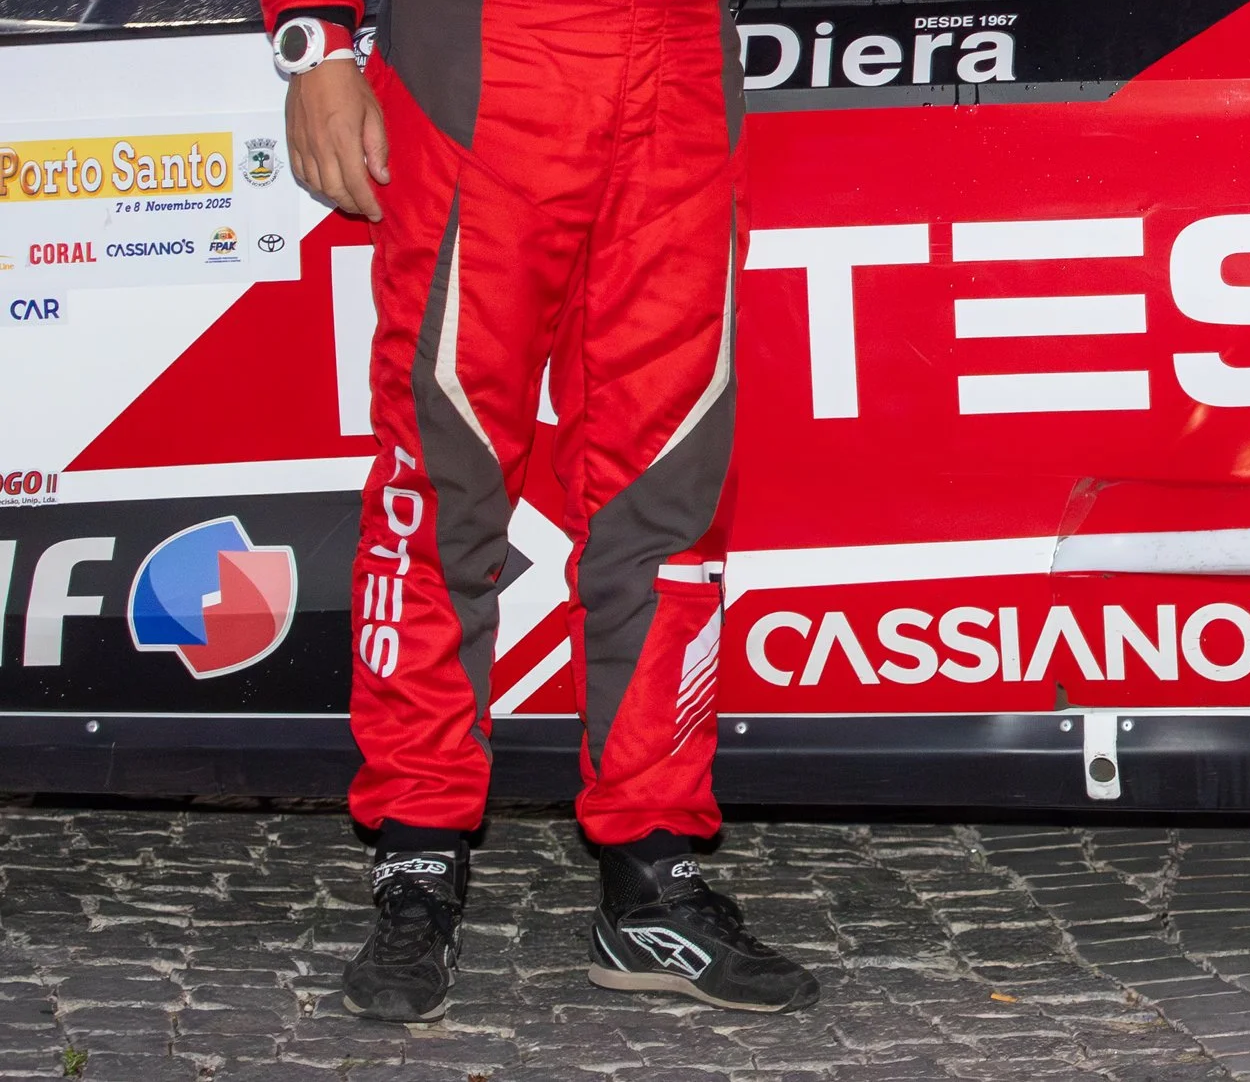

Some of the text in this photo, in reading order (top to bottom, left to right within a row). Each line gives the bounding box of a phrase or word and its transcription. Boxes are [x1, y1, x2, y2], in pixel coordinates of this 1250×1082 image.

[914, 14, 1018, 29] DESDE 1967
[735, 21, 1017, 90] Diera
[0, 140, 228, 196] Porto Santo
[115, 202, 123, 213] 7
[133, 202, 141, 212] 8
[145, 199, 204, 212] Novembro
[205, 198, 232, 210] 2025
[28, 241, 98, 266] CORAL
[106, 238, 196, 258] CASSIANO'S
[209, 241, 237, 252] FPAK
[10, 297, 60, 321] CAR
[358, 445, 425, 679] LOTES
